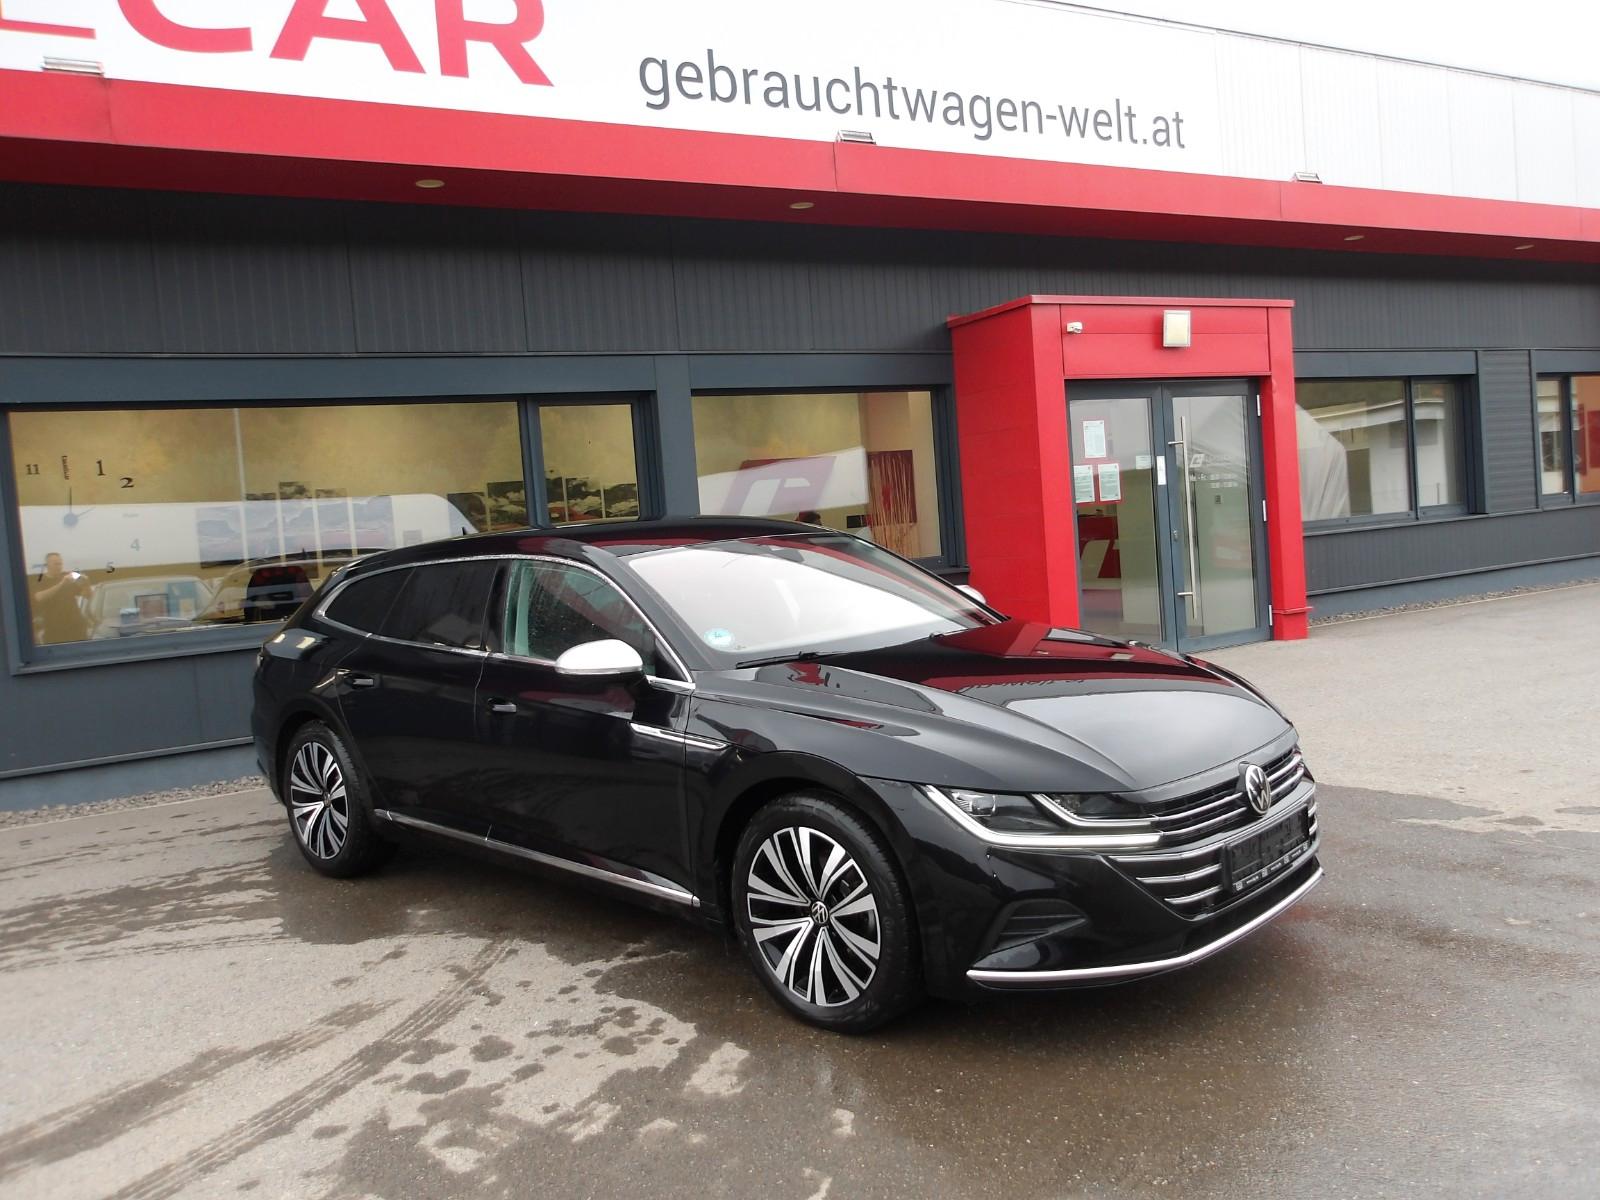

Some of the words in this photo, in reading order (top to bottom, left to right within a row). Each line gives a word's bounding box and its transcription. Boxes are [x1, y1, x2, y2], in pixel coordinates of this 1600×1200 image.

[0, 0, 552, 86] CAR
[638, 48, 1186, 149] gebrauchtwagen-welt.at
[96, 460, 105, 476] 1
[120, 477, 134, 488] 2
